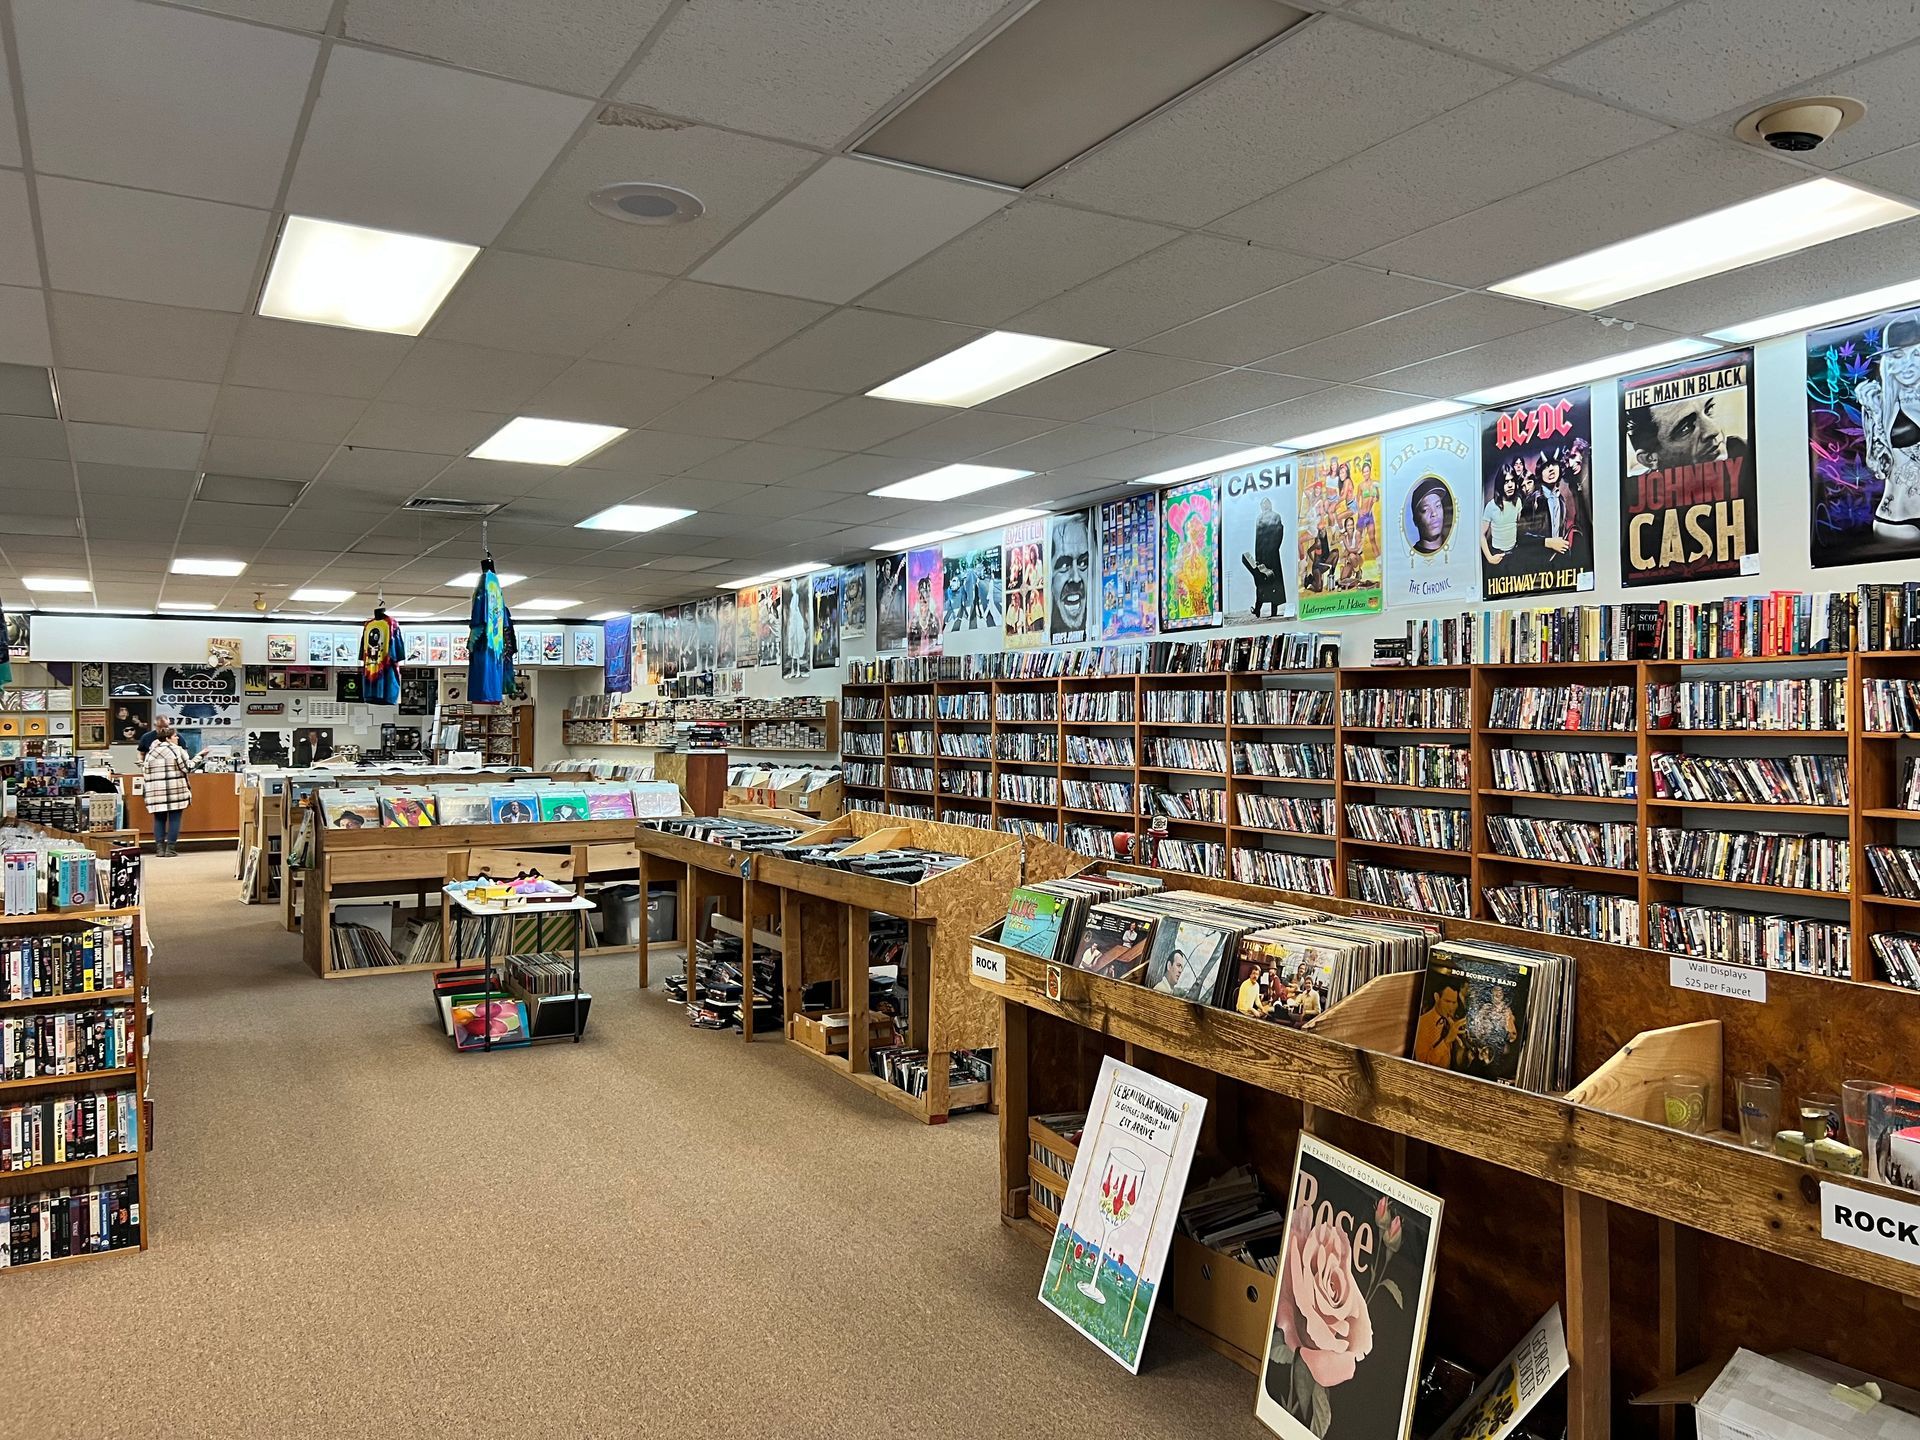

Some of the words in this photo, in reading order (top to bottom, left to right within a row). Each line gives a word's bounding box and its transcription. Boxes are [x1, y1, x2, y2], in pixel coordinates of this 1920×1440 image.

[1627, 388, 1650, 410] THE
[1653, 382, 1680, 402] MAN
[1683, 378, 1695, 396] IN
[1698, 367, 1742, 393] BLACK
[1389, 443, 1420, 476] DR.
[1423, 435, 1470, 460] DRE
[1228, 464, 1291, 498] CASH
[1629, 456, 1744, 513] JOHNNY
[1629, 498, 1746, 571] CASH
[1488, 573, 1537, 595] HIGHWAY
[1539, 571, 1553, 589] TO
[158, 694, 241, 704] CONNECTION
[173, 680, 227, 690] RECORD
[976, 956, 998, 973] ROCK
[1451, 968, 1464, 977] BOB
[1497, 978, 1517, 987] BAND
[1688, 962, 1708, 973] Wall
[1710, 966, 1748, 981] Displays
[1685, 977, 1701, 988] $25
[1703, 982, 1718, 990] per
[1721, 983, 1751, 997] Faucet
[1113, 1084, 1123, 1098] LE
[1121, 1086, 1155, 1110] BEAUJOLAIS
[1154, 1103, 1180, 1123] NOUVEAU
[1119, 1116, 1131, 1128] EST
[1302, 1143, 1312, 1154] AN
[1312, 1147, 1347, 1170] EXHIBITION
[1347, 1165, 1357, 1176] OF
[1357, 1169, 1396, 1197] BOTANICAL
[1397, 1189, 1434, 1216] PAINTINGS
[1296, 1170, 1374, 1273] Rose
[1834, 1204, 1920, 1246] ROCK
[1532, 1328, 1551, 1386] GEORGES
